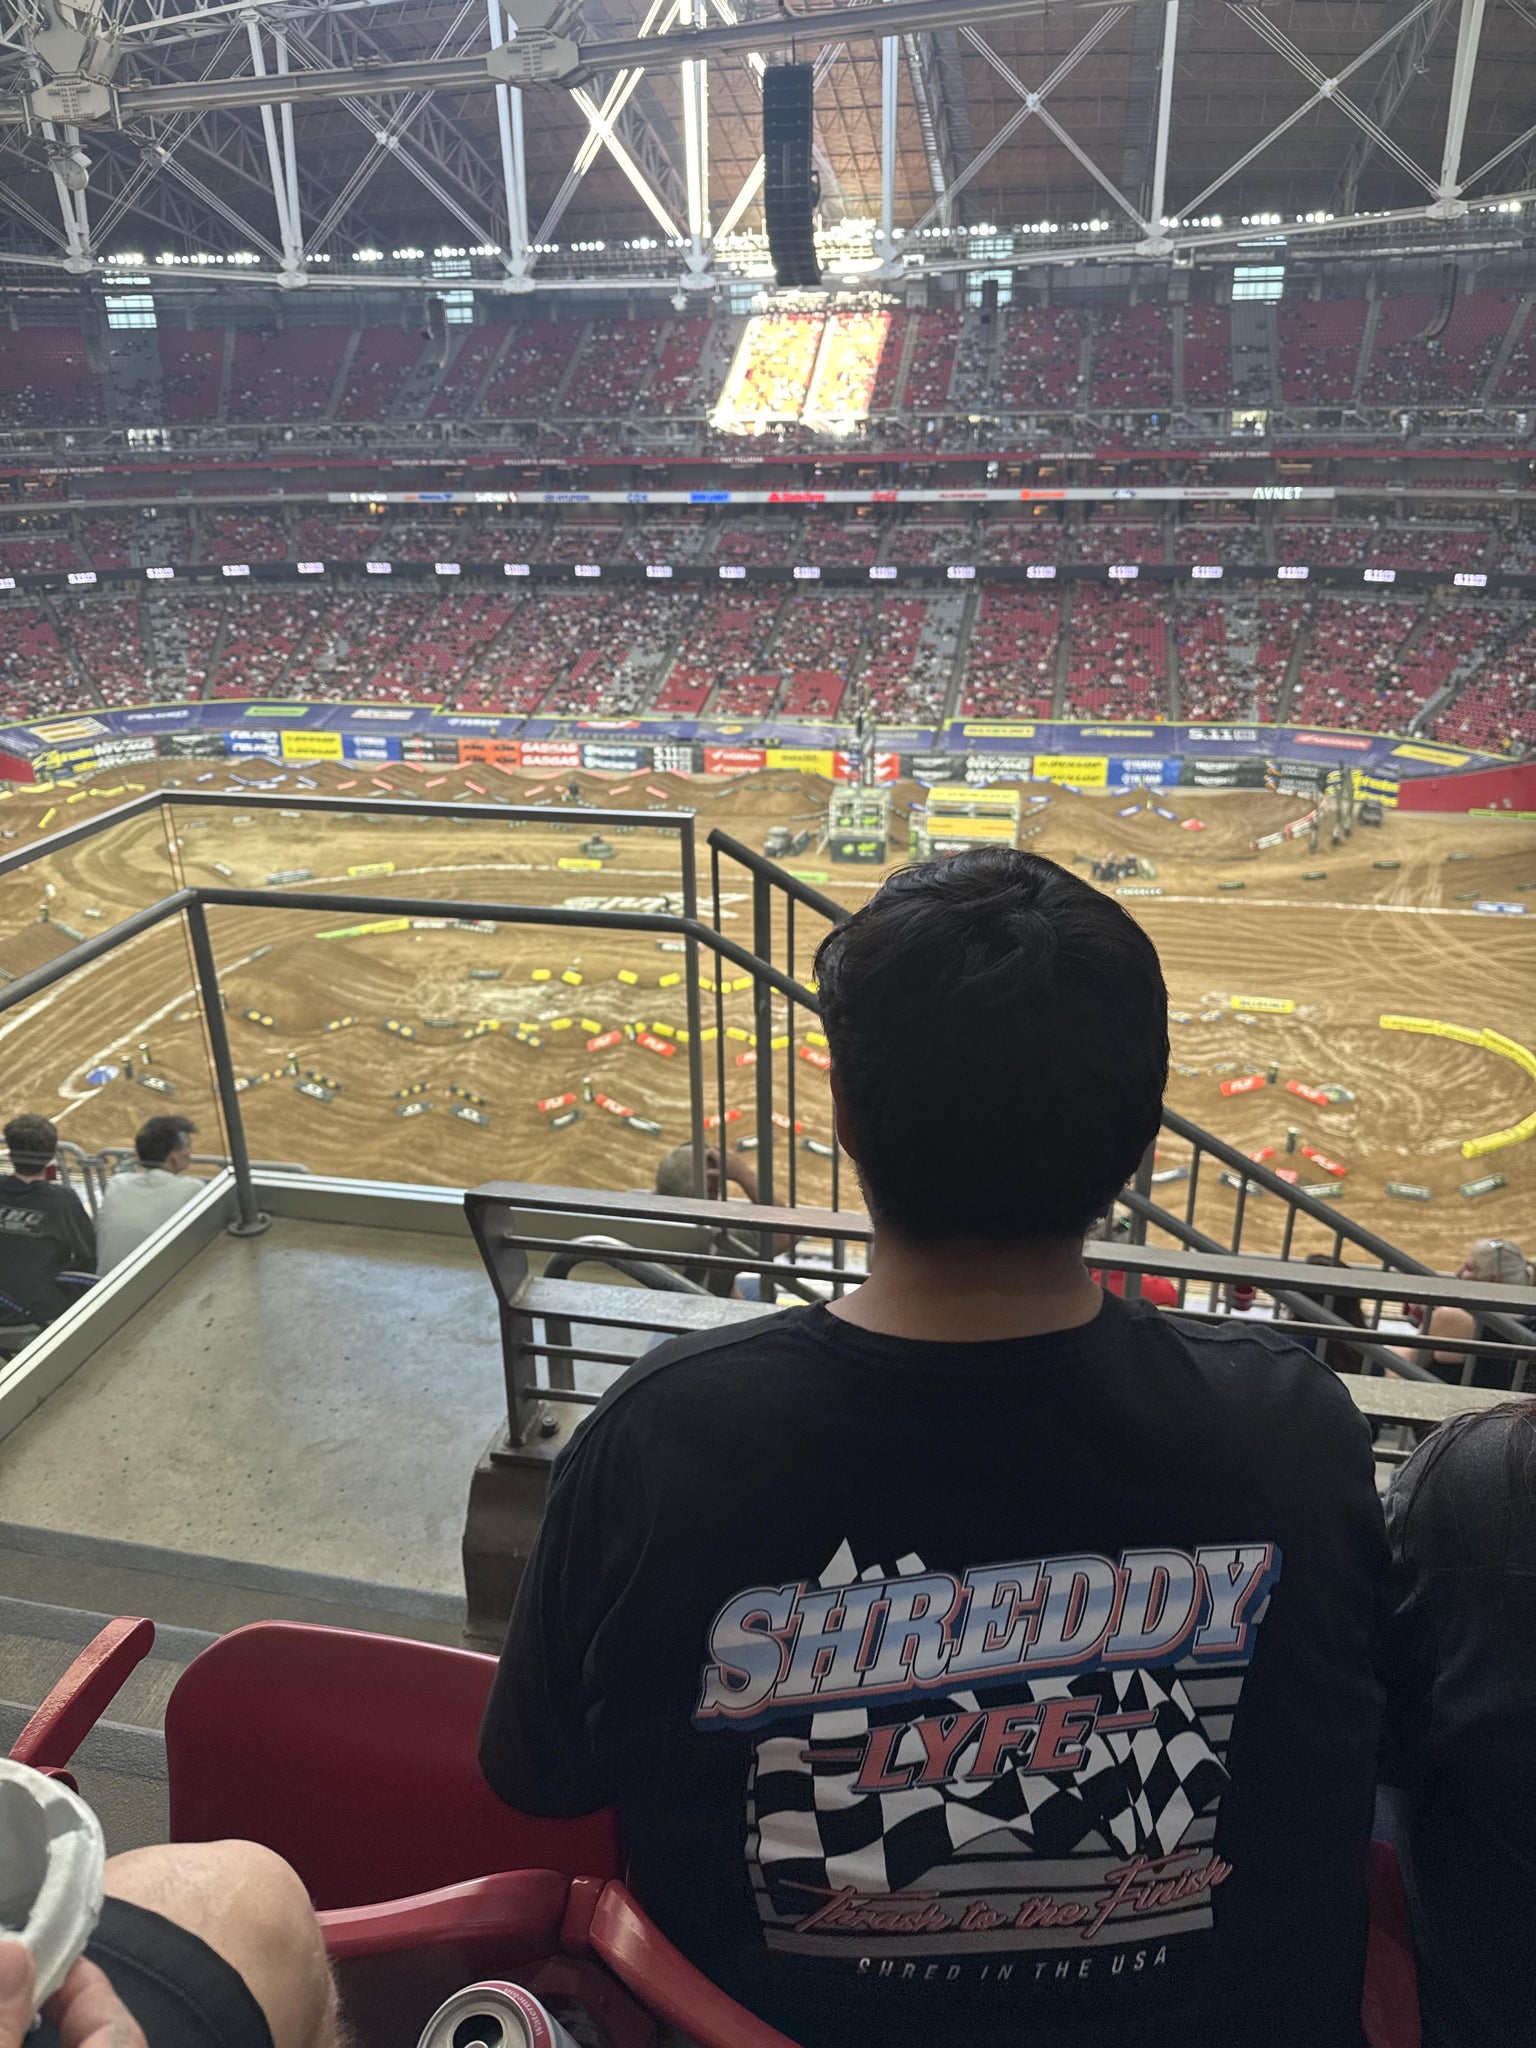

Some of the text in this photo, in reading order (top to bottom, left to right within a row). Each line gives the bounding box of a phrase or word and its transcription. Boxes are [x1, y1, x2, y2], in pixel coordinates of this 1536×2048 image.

[1252, 486, 1303, 500] AVNET
[520, 743, 578, 753] GASGAS
[521, 755, 580, 766] GASGAS
[692, 1541, 1283, 1730] SHREDDY
[850, 1695, 1103, 1794] LYFE
[780, 1848, 1233, 1941] Thrash to the Finish
[857, 1945, 1168, 1984] SHRED IN THE USA
[504, 1988, 545, 2037] Watermelon
